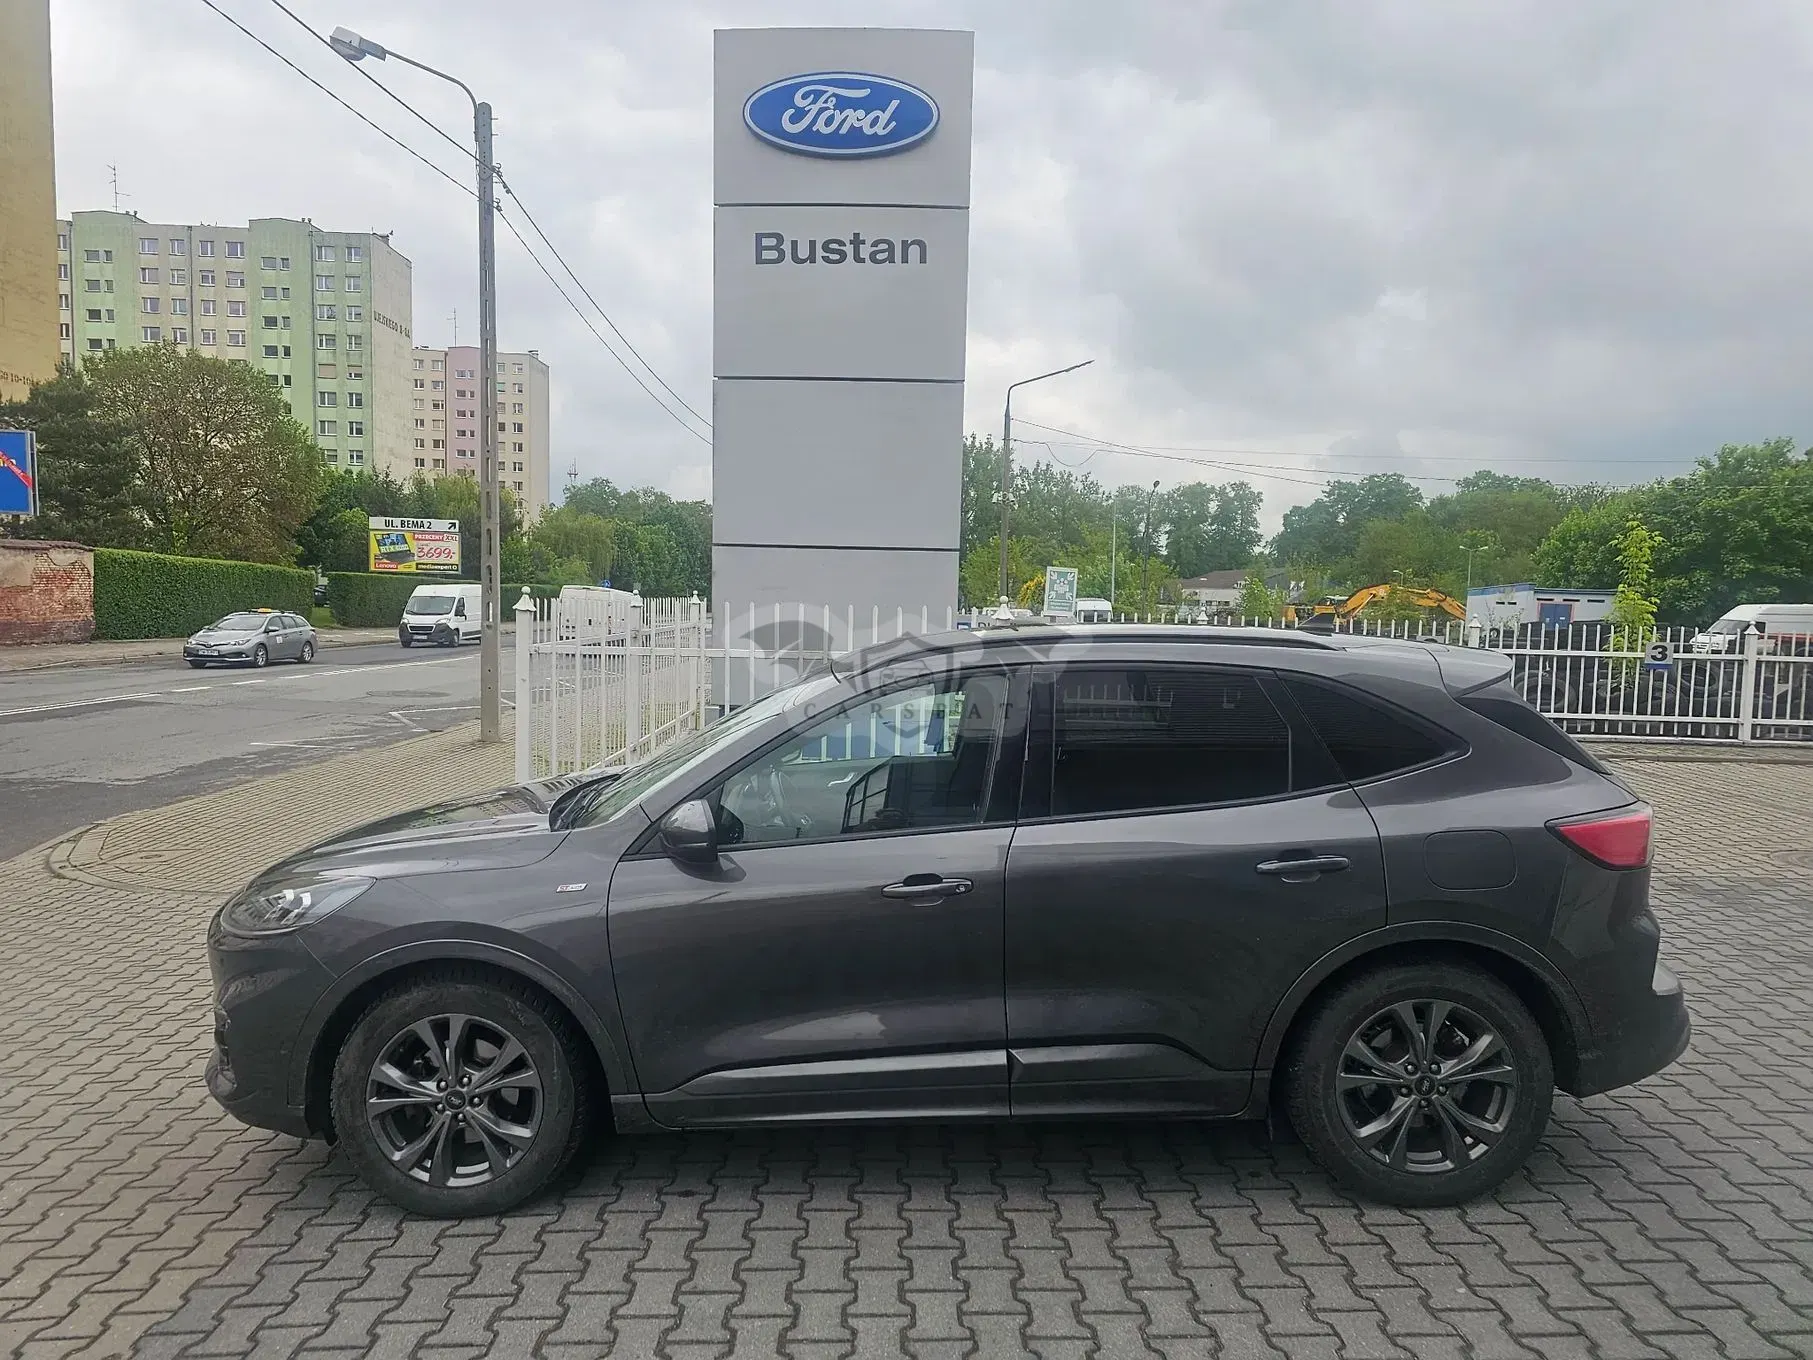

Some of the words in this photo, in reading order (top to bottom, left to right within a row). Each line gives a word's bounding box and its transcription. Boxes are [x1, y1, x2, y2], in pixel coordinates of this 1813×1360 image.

[781, 84, 901, 136] Ford
[754, 232, 928, 265] Bustan
[384, 519, 399, 528] UL.
[400, 520, 425, 529] BEMA
[426, 520, 432, 530] 2
[1650, 644, 1668, 662] 3
